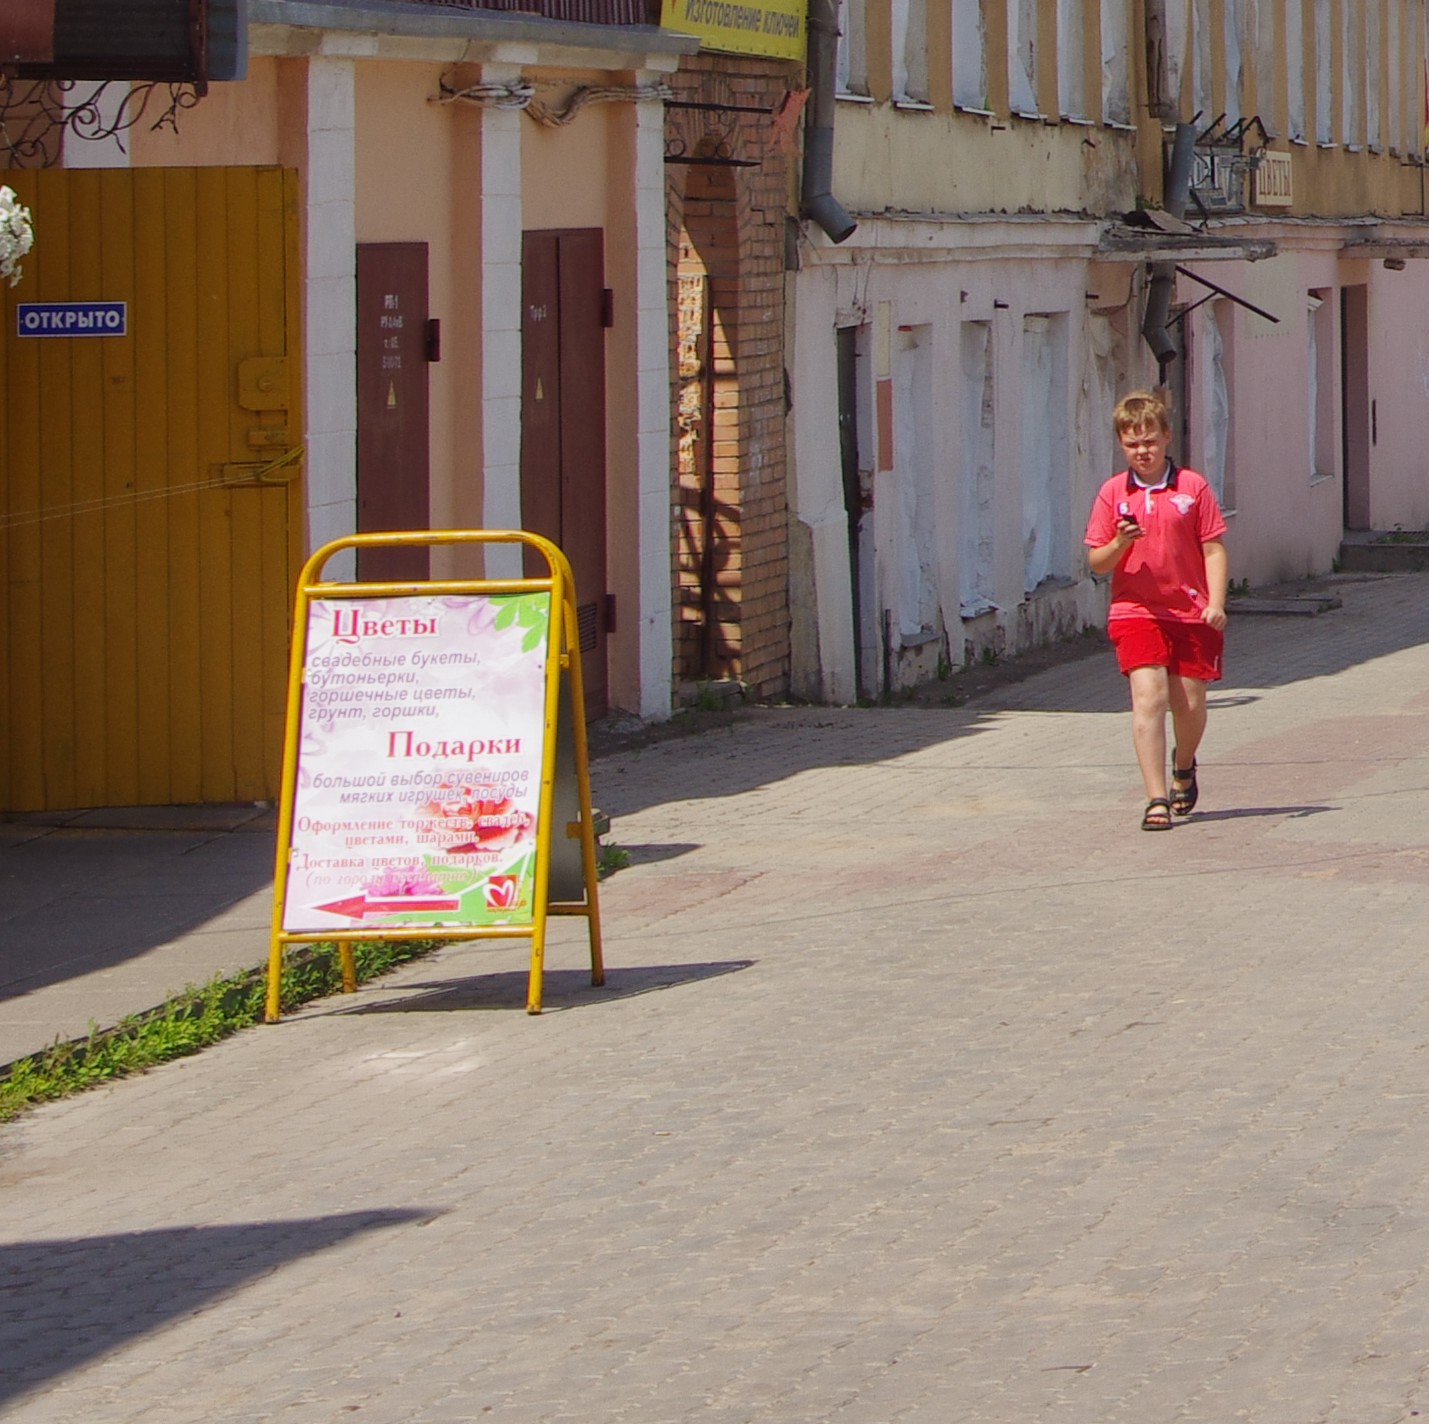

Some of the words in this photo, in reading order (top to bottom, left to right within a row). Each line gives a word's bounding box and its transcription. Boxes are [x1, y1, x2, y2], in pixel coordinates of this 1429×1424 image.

[763, 8, 800, 38] ключей
[25, 310, 120, 329] ОТКРЫТО
[332, 609, 437, 644] Цветы
[312, 652, 406, 667] свадебные
[411, 650, 480, 668] букеты,
[311, 670, 419, 688] бутоньерки,
[309, 688, 408, 703] горшечные
[413, 685, 476, 701] цветы,
[308, 706, 367, 722] грунт,
[371, 703, 440, 719] горшки,
[387, 730, 522, 762] Подарки
[313, 772, 385, 788] большой
[391, 769, 442, 788] выбор
[447, 769, 529, 786] сувениров
[339, 790, 394, 804] мягких
[298, 816, 394, 833] Оформление
[345, 833, 409, 849] цветами,
[297, 853, 365, 871] Доставка
